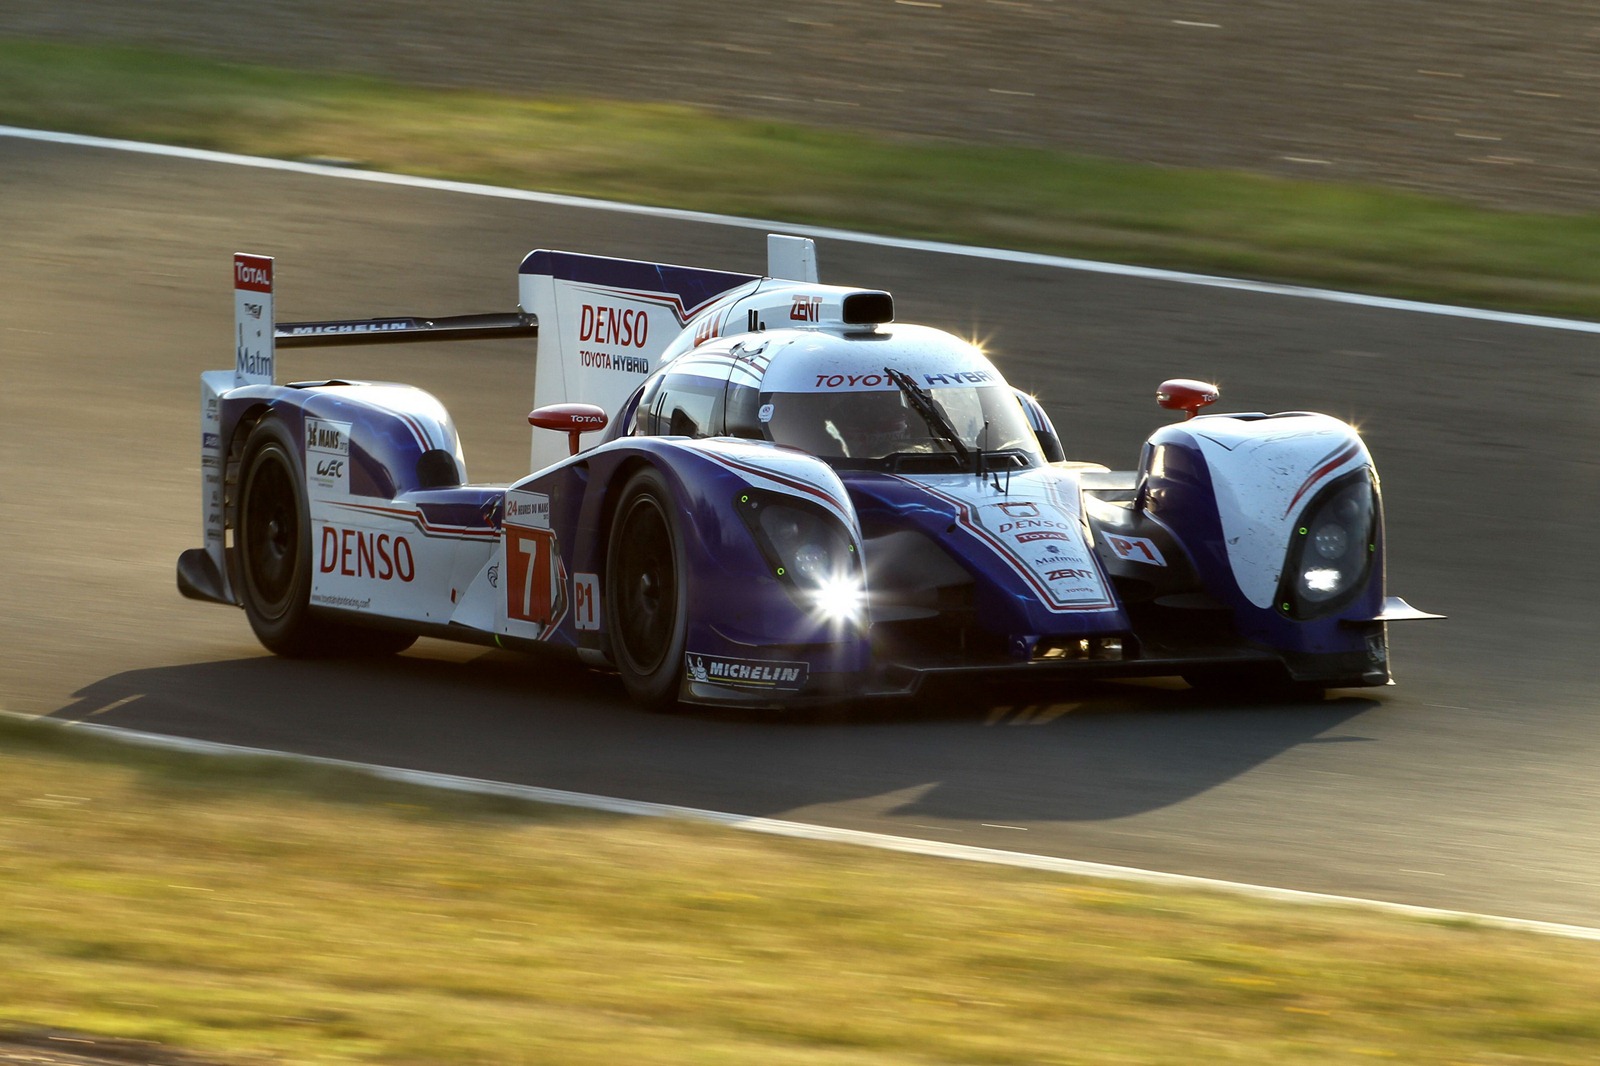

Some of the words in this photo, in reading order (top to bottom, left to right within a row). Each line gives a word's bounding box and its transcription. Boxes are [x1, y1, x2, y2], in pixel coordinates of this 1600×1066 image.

[235, 261, 270, 285] TOTAL
[790, 295, 823, 322] ZENT
[293, 323, 407, 334] MICHELIN
[579, 304, 648, 348] DENSO
[580, 351, 612, 370] TOYOTA
[612, 354, 649, 375] HYBRID
[570, 414, 604, 423] TOTAL
[318, 428, 340, 450] MANS
[316, 460, 344, 478] WEC
[507, 500, 517, 516] 24
[538, 503, 549, 514] MANS
[999, 519, 1069, 534] DENSO
[1018, 532, 1069, 541] TOTAL
[320, 526, 415, 582] DENSO
[1108, 536, 1156, 560] P1
[518, 537, 537, 617] 7
[1045, 568, 1094, 581] ZENT
[575, 582, 594, 623] P1
[709, 661, 800, 682] MICHELIN
